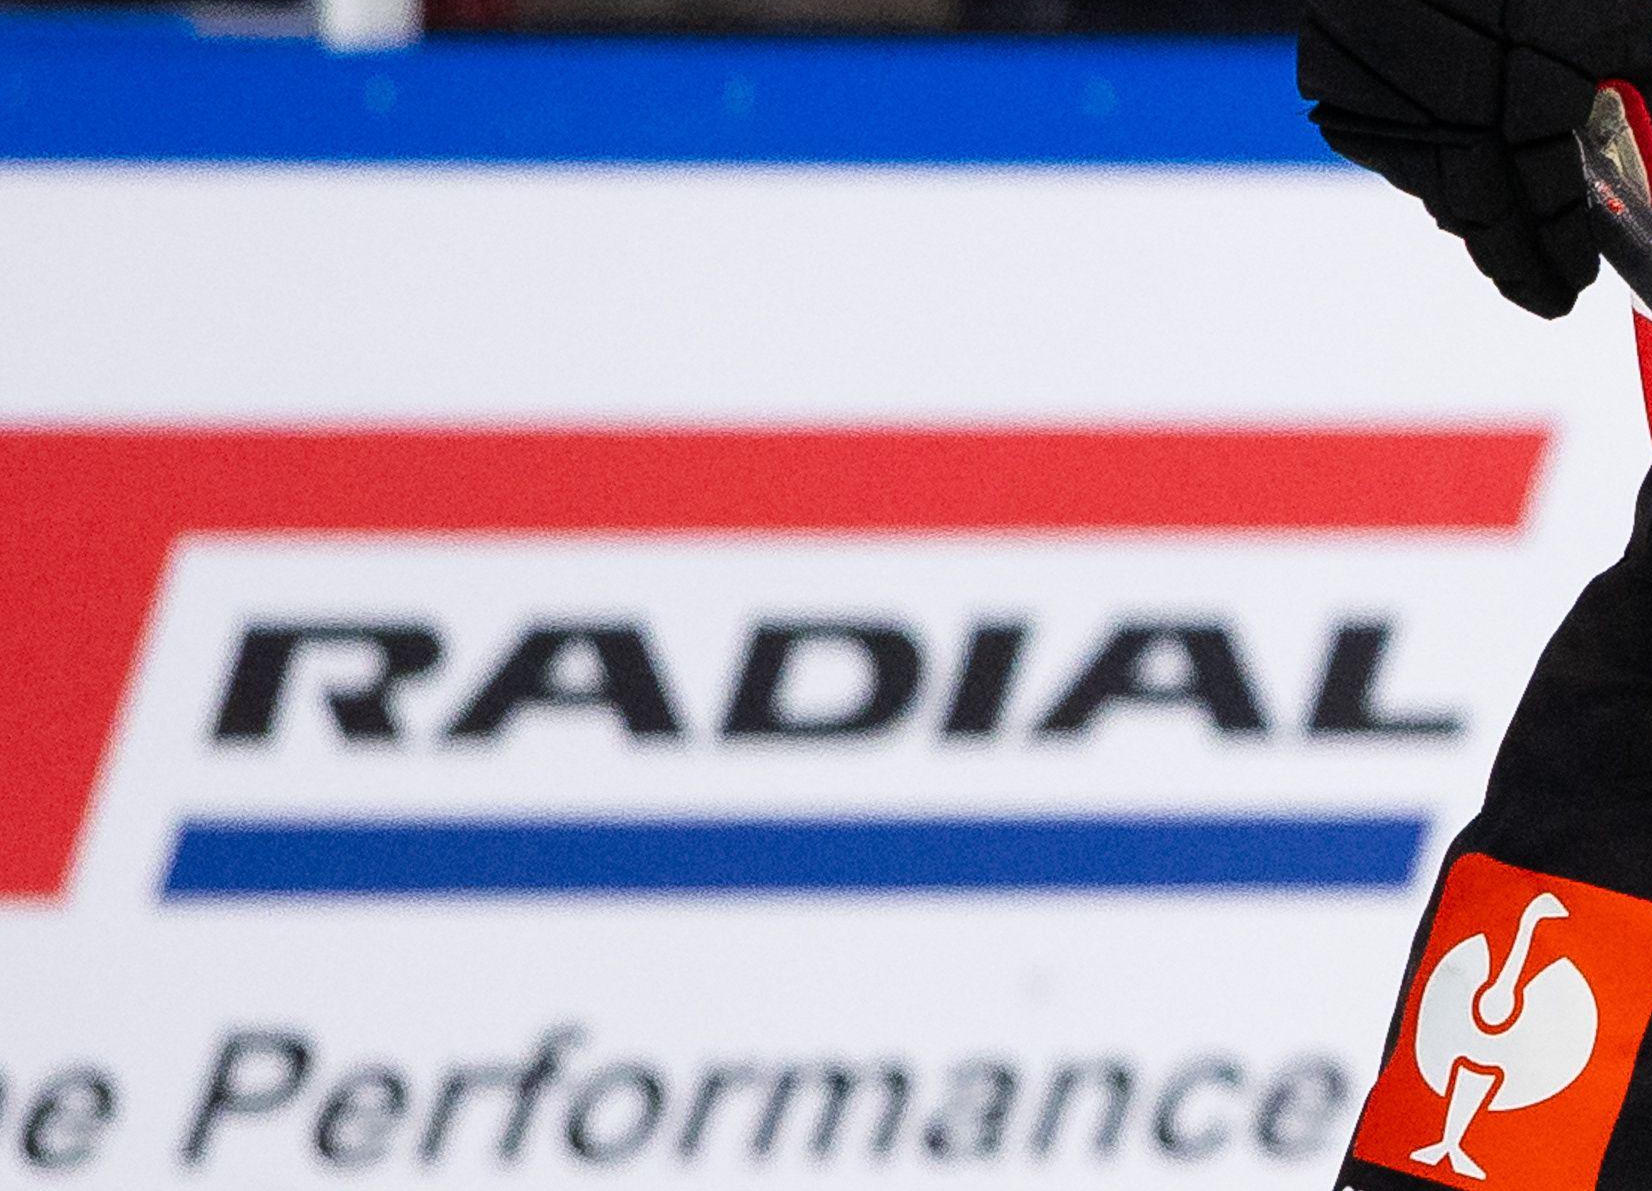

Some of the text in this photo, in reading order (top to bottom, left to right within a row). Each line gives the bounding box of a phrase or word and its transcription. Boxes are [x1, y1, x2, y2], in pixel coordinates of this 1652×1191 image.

[210, 620, 1465, 744] RADIAL
[0, 1022, 1350, 1173] e Performance
